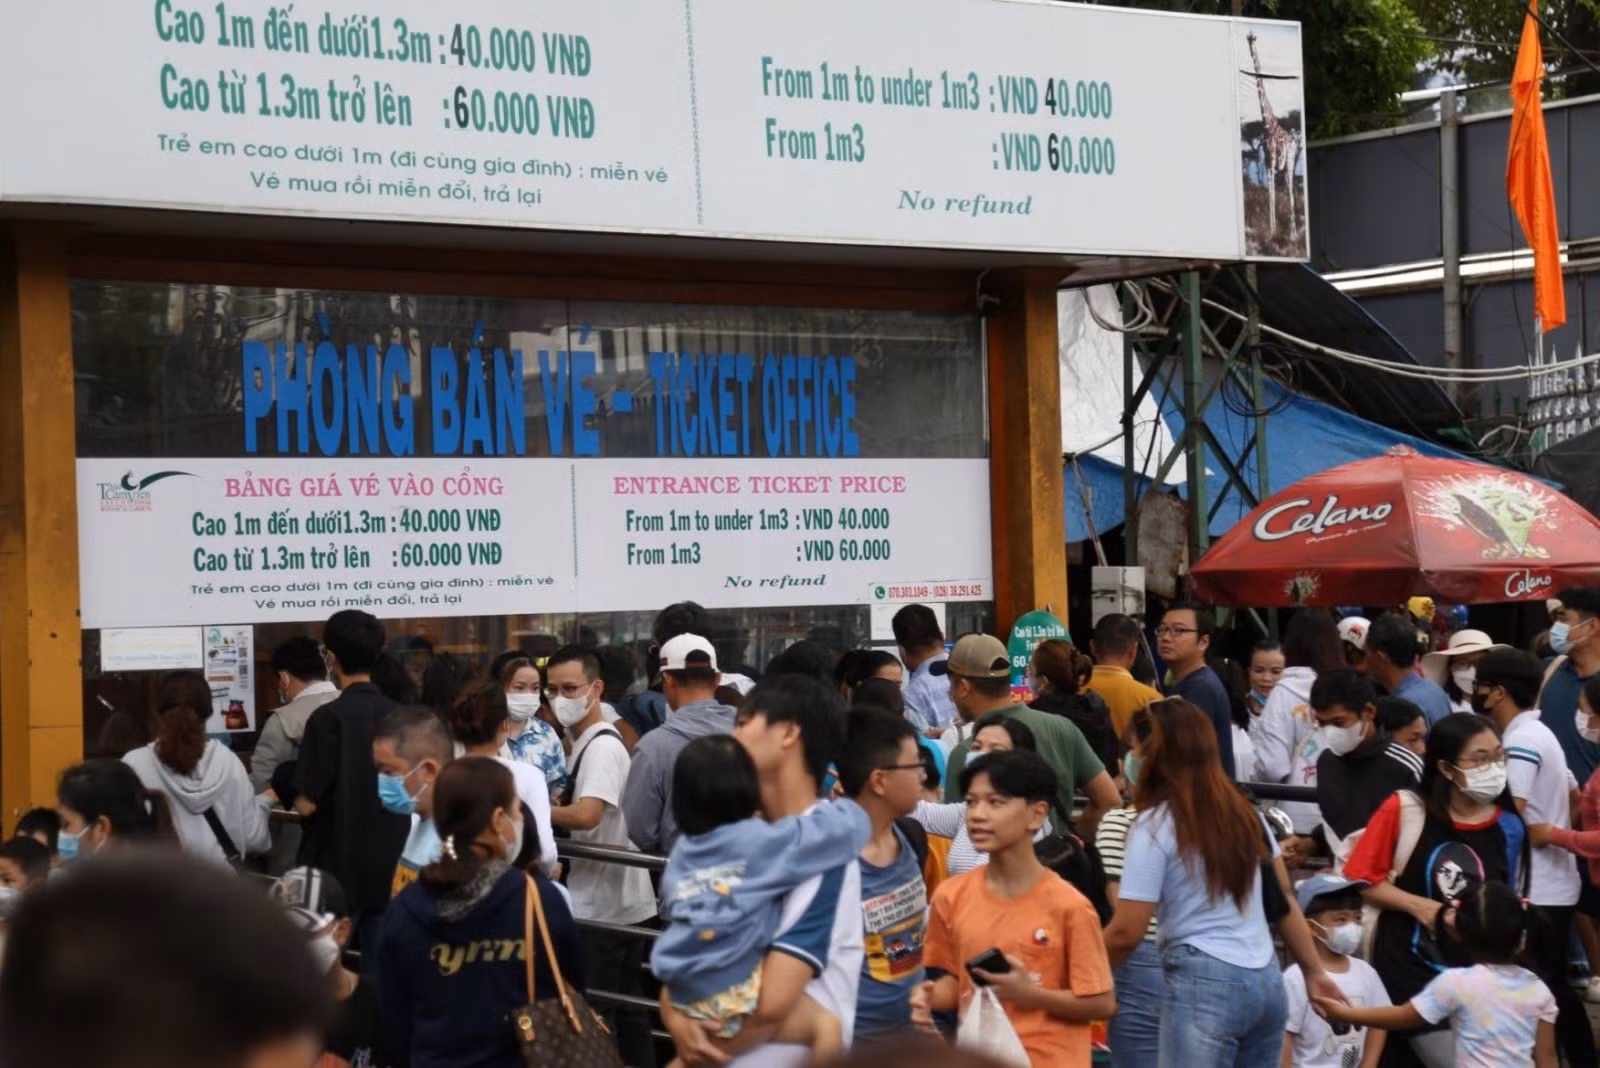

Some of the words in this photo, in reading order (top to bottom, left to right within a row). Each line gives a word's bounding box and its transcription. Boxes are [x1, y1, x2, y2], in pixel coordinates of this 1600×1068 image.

[154, 0, 205, 45] Cao
[215, 1, 255, 49] 1m
[263, 3, 310, 54] đến
[541, 31, 592, 78] VNĐ
[159, 62, 211, 113] Cao
[217, 68, 248, 115] từ
[256, 71, 321, 120] 1.3m
[327, 74, 367, 124] trở
[373, 80, 413, 127] lên
[546, 94, 596, 140] VNĐ
[761, 55, 814, 100] From
[820, 61, 850, 102] 1m
[854, 65, 875, 104] to
[880, 67, 933, 108] under
[940, 70, 980, 111] 1m3
[1044, 77, 1113, 120] 40.000
[157, 132, 191, 153] Trẻ
[198, 140, 236, 156] em
[242, 143, 288, 159] cao
[294, 144, 343, 163] dưới
[352, 147, 383, 165] 1m
[389, 150, 417, 168] (đi
[423, 152, 477, 175] cùng
[483, 157, 516, 177] gia
[522, 158, 572, 179] đình)
[590, 161, 639, 181] miễn
[644, 166, 668, 183] vé
[765, 117, 817, 161] From
[823, 121, 866, 164] 1m3
[1046, 132, 1116, 176] 60.000
[250, 171, 281, 190] Vé
[288, 177, 338, 194] mua
[344, 174, 372, 195] rồi
[378, 177, 431, 198] miễn
[483, 183, 510, 203] trả
[517, 187, 542, 208] lại
[897, 190, 936, 211] No
[944, 193, 1034, 218] refund
[242, 310, 415, 457] PHÒNG
[430, 320, 527, 456] BÁN
[539, 321, 601, 457] VÉ
[648, 350, 755, 457] TICKET
[761, 353, 861, 457] OFFICE
[224, 470, 293, 498] BẢNG
[299, 472, 343, 497] GIÁ
[348, 472, 381, 497] VÉ
[387, 472, 435, 497] VÀO
[442, 466, 505, 497] CỔNG
[613, 476, 742, 495] ENTRANCE
[747, 475, 833, 494] TICKET
[839, 475, 907, 494] PRICE
[191, 511, 228, 537] Cao
[233, 510, 262, 536] 1m
[266, 507, 300, 535] đến
[465, 507, 502, 533] VNĐ
[625, 508, 665, 533] From
[668, 508, 692, 532] 1m
[693, 508, 711, 532] to
[714, 508, 754, 532] under
[758, 507, 790, 531] 1m3
[837, 506, 891, 531] 40.000
[1253, 494, 1394, 541] Celano
[192, 546, 229, 573] Cao
[232, 546, 255, 572] từ
[260, 545, 306, 571] 1.3m
[309, 541, 339, 570] trở
[343, 544, 371, 569] lên
[466, 541, 503, 567] VNĐ
[626, 542, 666, 566] From
[670, 541, 702, 565] 1m3
[838, 538, 892, 563] 60.000
[191, 582, 215, 595] Trẻ
[219, 584, 246, 594] em
[249, 584, 282, 593] cao
[326, 580, 349, 591] 1m
[419, 578, 444, 591] gia
[536, 575, 555, 586] vé
[723, 575, 753, 589] No
[759, 573, 827, 590] refund
[1504, 568, 1552, 598] Celano
[254, 598, 277, 609] Vé
[281, 599, 317, 609] mua
[419, 592, 440, 605] trả
[443, 593, 462, 606] lại
